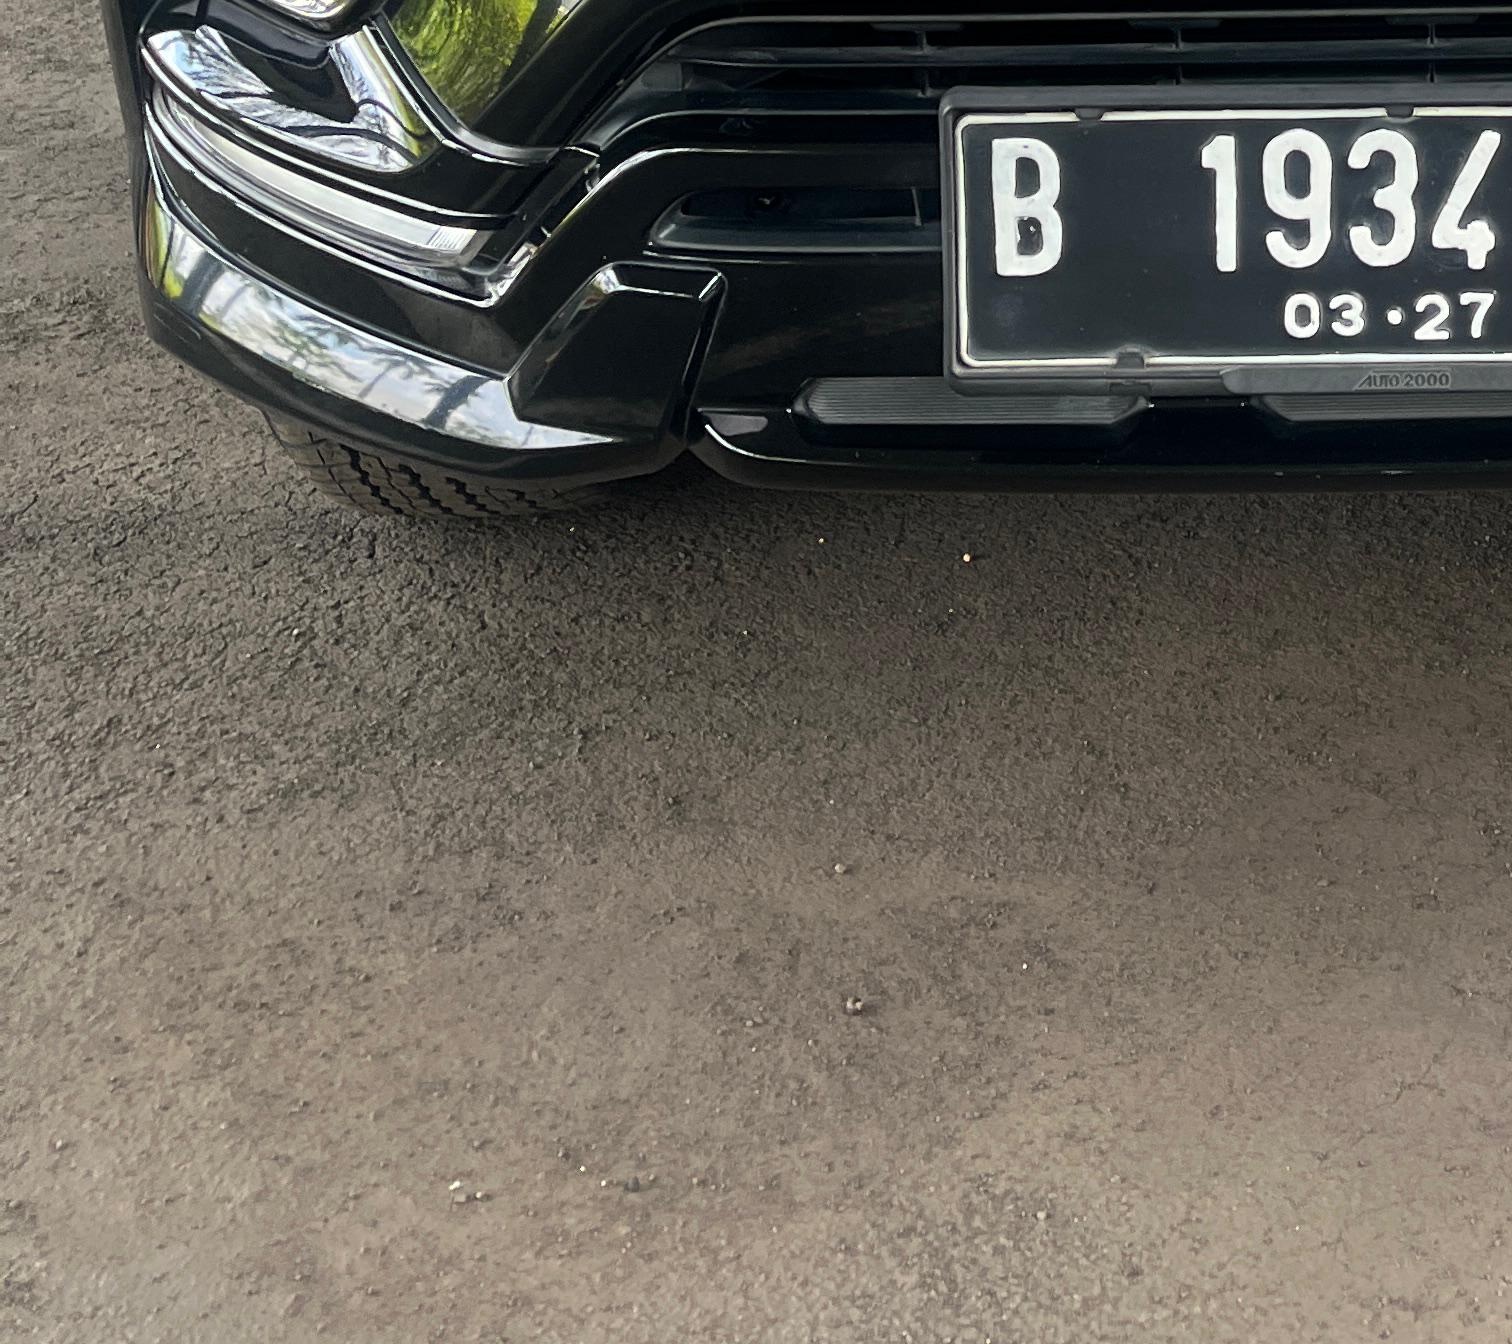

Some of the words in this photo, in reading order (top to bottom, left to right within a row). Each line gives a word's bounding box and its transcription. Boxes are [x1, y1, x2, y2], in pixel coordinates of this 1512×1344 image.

[991, 137, 1063, 277] B
[1200, 127, 1502, 272] 1934
[1356, 373, 1400, 389] AUTO
[1402, 372, 1451, 389] 2000
